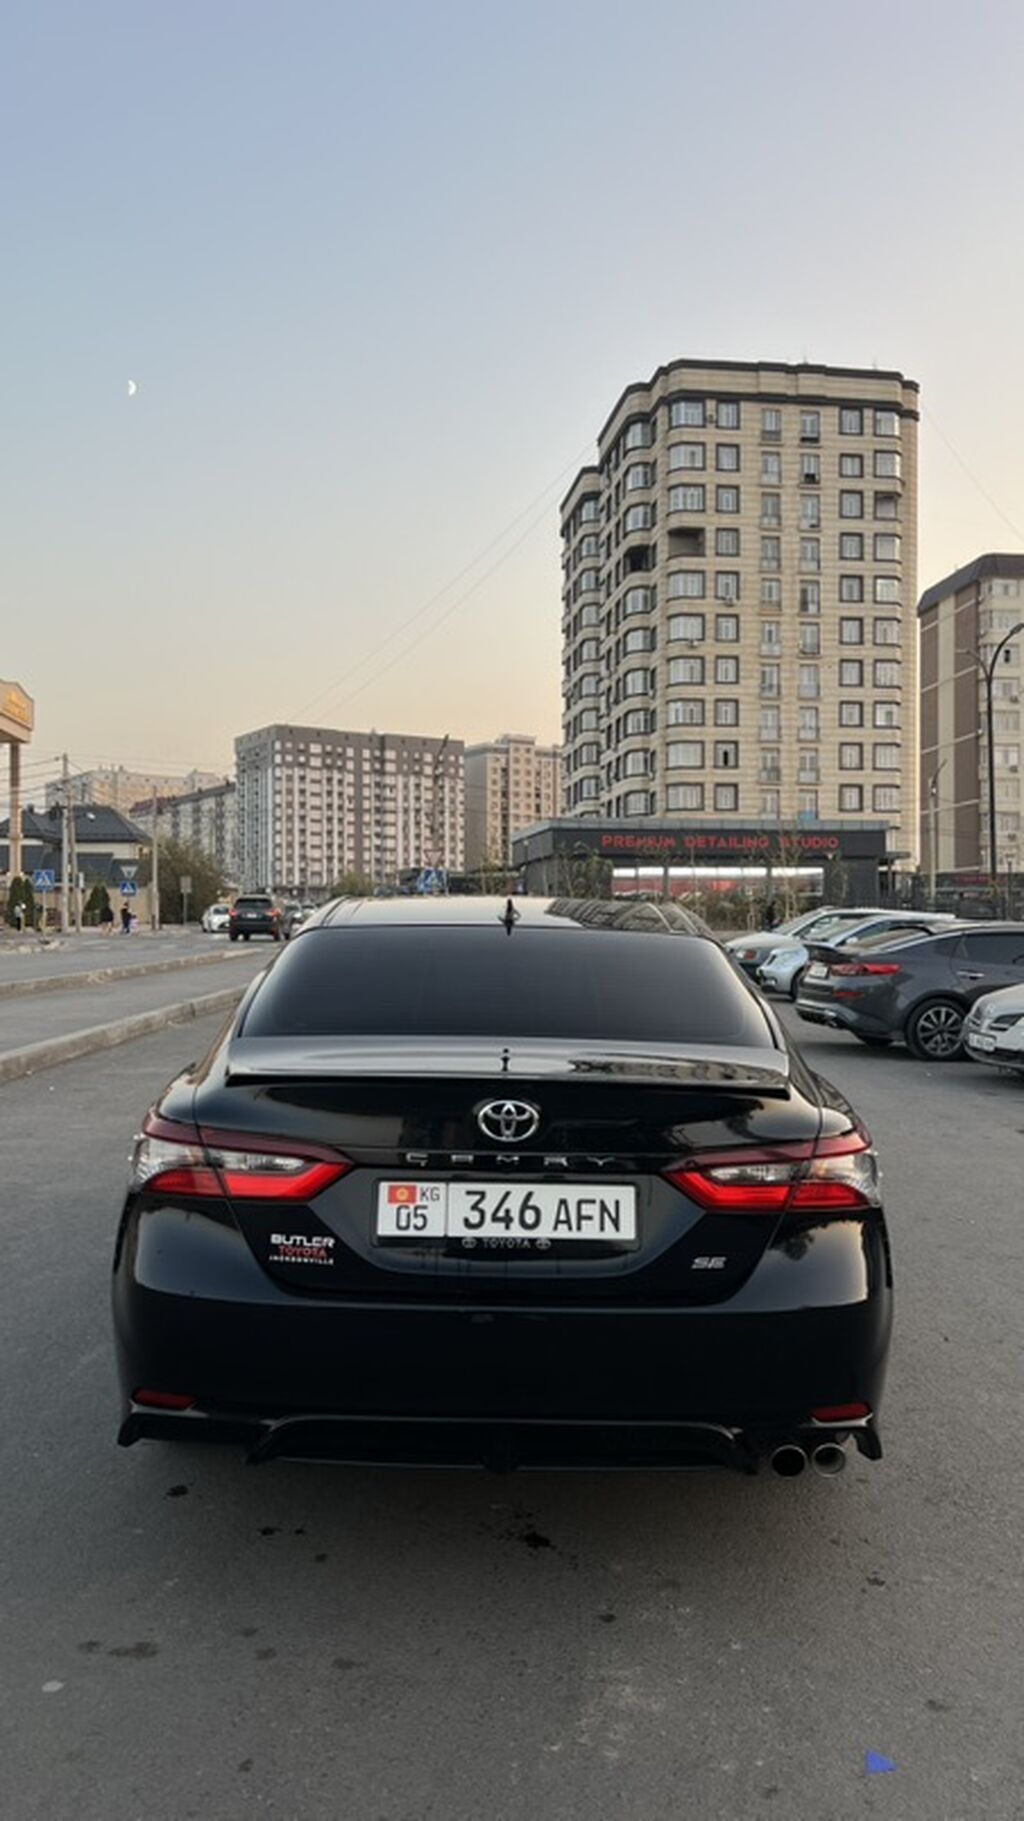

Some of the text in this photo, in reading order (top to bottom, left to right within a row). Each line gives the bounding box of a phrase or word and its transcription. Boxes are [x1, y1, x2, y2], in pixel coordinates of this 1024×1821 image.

[602, 835, 840, 849] PREMIUM DETAILING STUDIO
[406, 1152, 615, 1166] CAMRY
[420, 1187, 440, 1202] KG
[395, 1205, 428, 1231] 05
[463, 1191, 621, 1233] 346 AFN
[270, 1233, 336, 1249] BUTLER
[483, 1238, 531, 1249] TOYOTA
[279, 1246, 328, 1259] TOYOTA
[691, 1256, 727, 1269] SE
